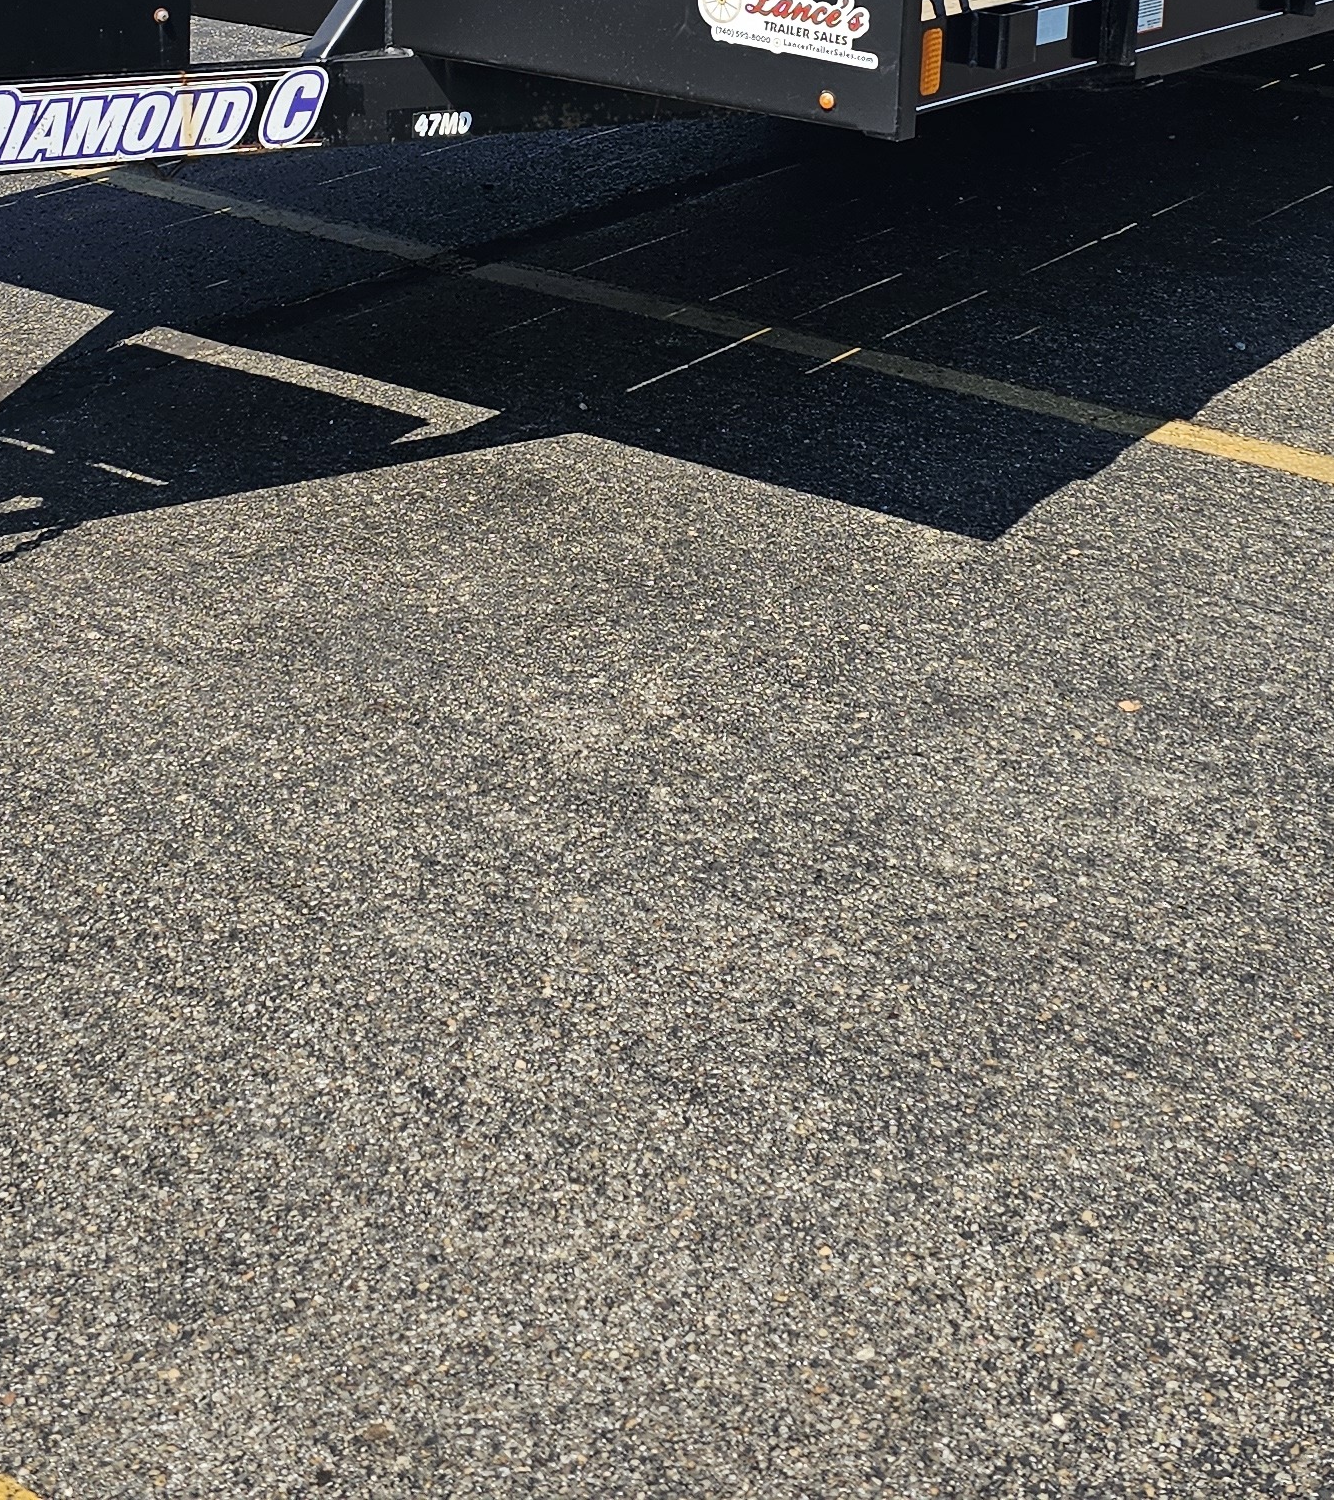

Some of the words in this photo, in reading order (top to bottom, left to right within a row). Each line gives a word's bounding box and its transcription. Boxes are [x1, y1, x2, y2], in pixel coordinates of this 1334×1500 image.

[715, 26, 734, 38] (740)
[783, 38, 874, 64] LancesTrailerSales.com
[764, 21, 810, 39] TRAILER
[813, 31, 848, 46] SALES
[264, 69, 323, 145] C
[414, 111, 472, 137] 47MD
